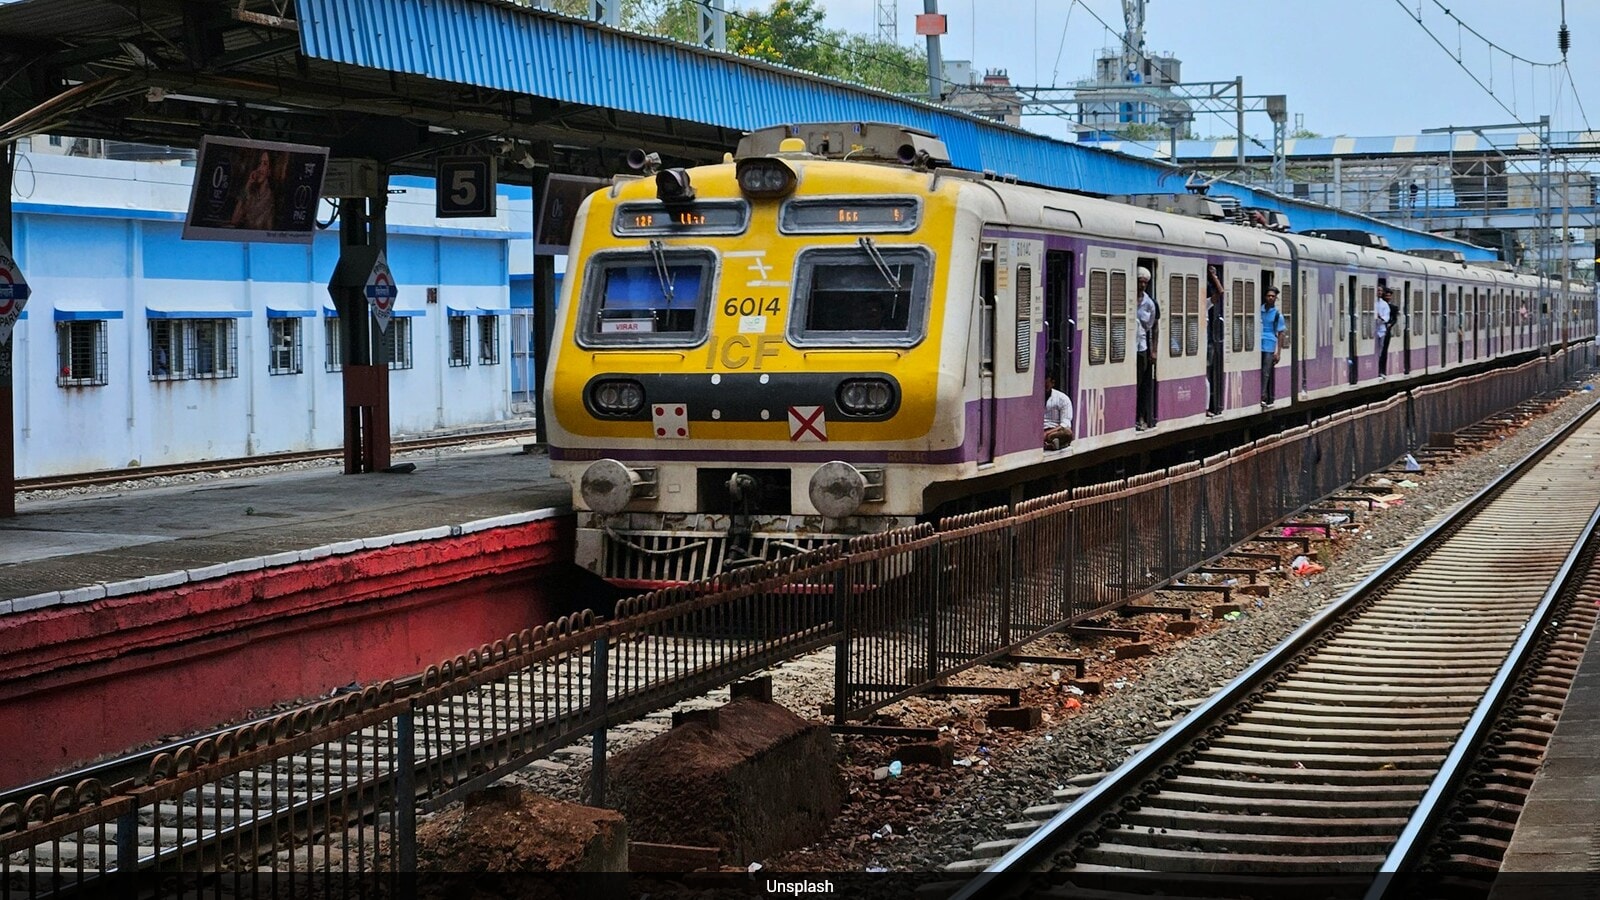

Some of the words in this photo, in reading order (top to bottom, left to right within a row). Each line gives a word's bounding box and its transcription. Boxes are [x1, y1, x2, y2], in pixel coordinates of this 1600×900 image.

[451, 170, 477, 206] 5
[724, 297, 781, 316] 6014
[616, 323, 638, 331] VIRAR
[705, 335, 784, 370] ICF
[1086, 387, 1106, 437] WR
